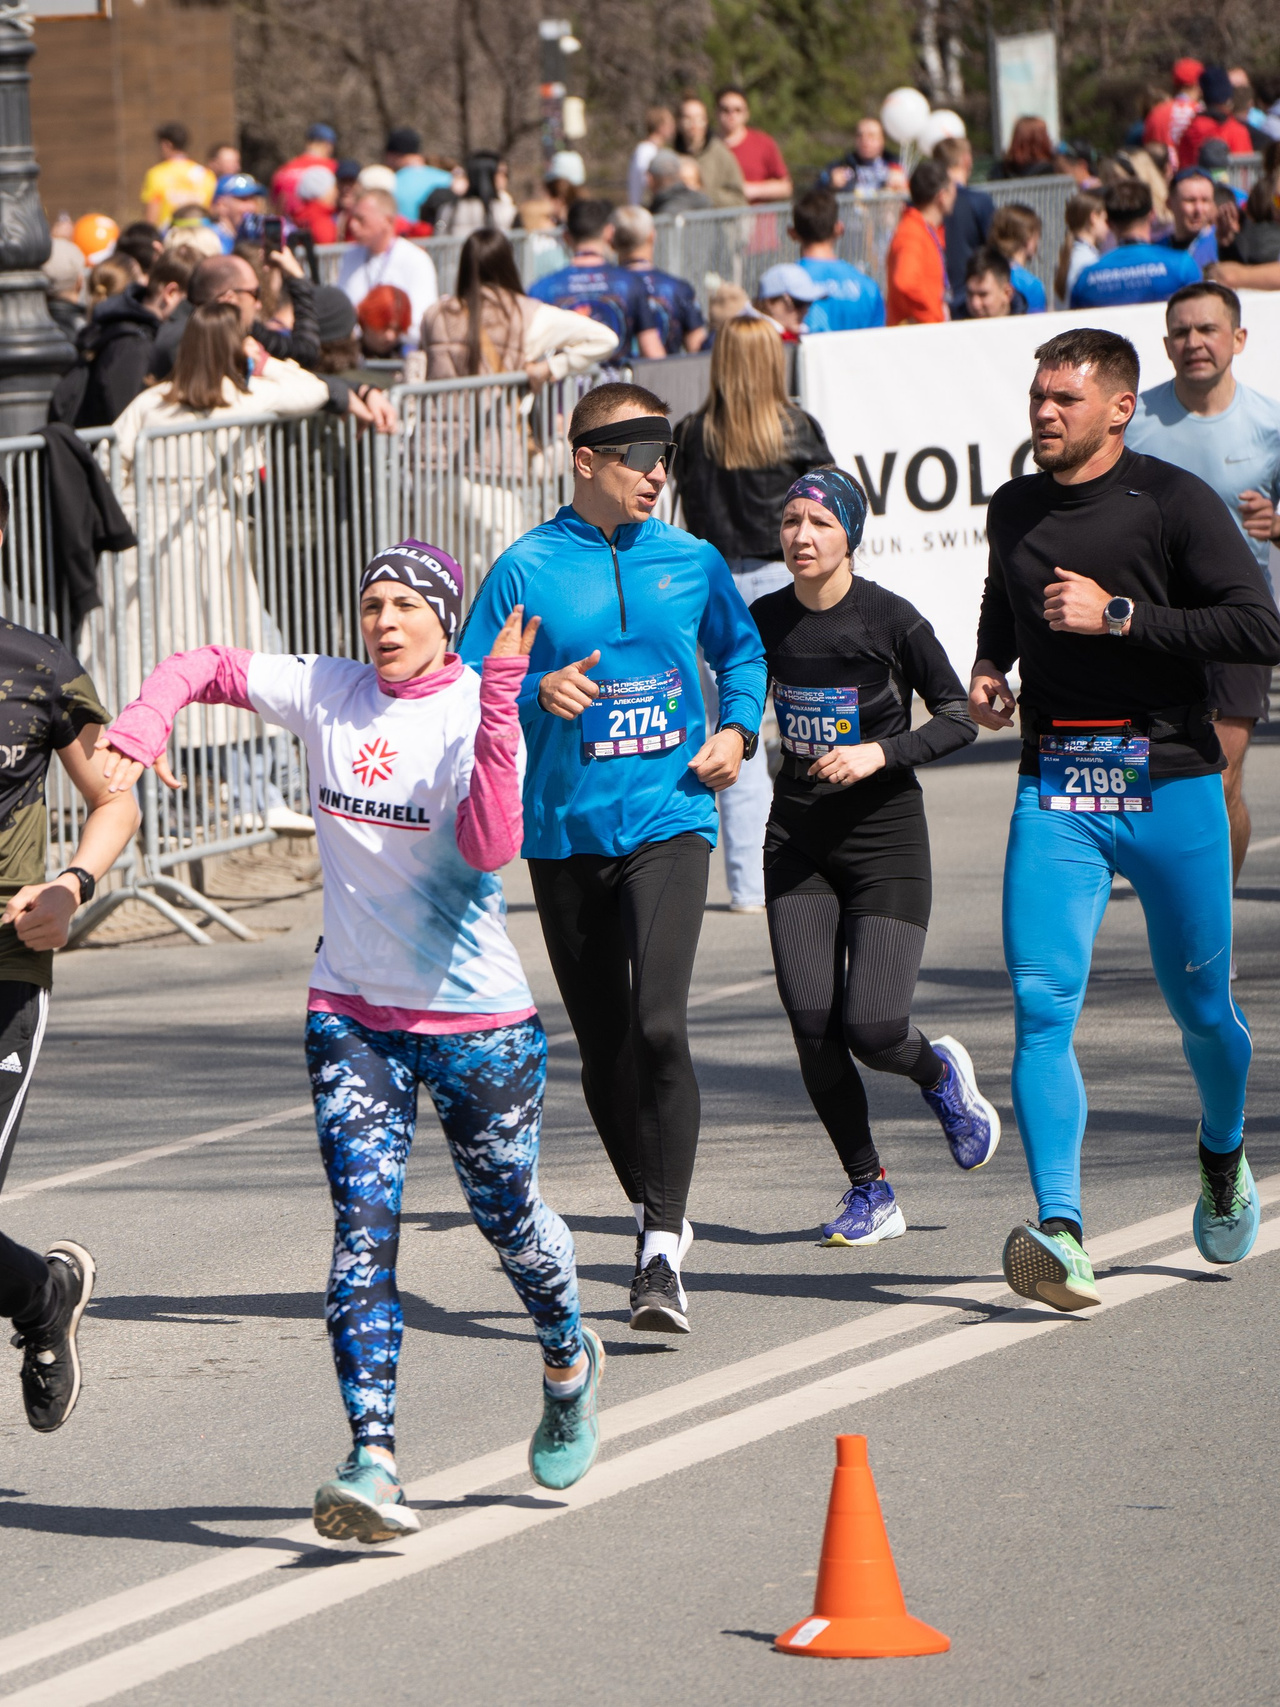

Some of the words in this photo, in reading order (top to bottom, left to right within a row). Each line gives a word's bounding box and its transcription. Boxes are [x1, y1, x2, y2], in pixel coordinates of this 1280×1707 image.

[613, 695, 655, 706] АЛЕКСАНДР
[608, 705, 668, 738] 2174
[785, 713, 837, 743] 2015
[1064, 766, 1127, 794] 2198
